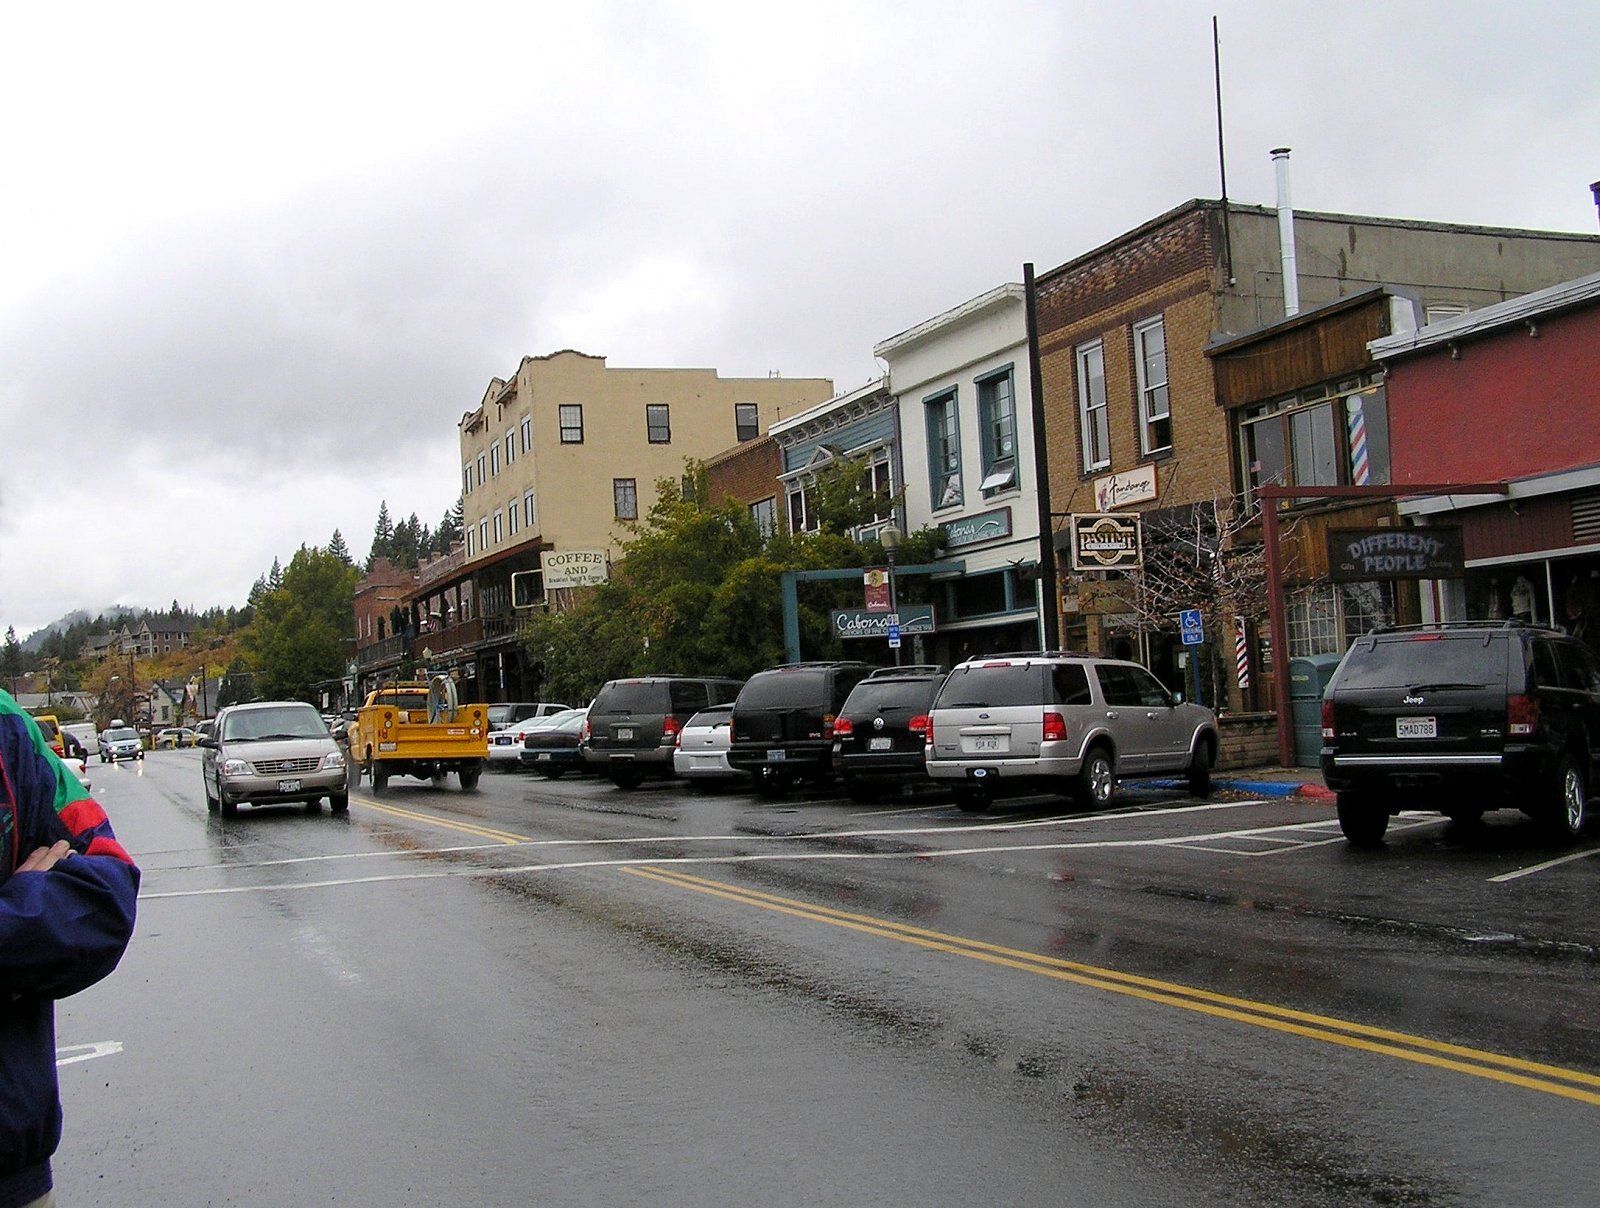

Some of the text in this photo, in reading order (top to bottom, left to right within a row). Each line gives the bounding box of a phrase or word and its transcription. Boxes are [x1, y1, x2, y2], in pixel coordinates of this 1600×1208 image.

[1080, 532, 1136, 551] PASTIME
[1347, 532, 1445, 559] DIFFERENT
[547, 553, 602, 567] COFFEE
[1361, 554, 1427, 573] PEOPLE
[564, 566, 588, 574] AND
[1403, 696, 1424, 704] Jeep
